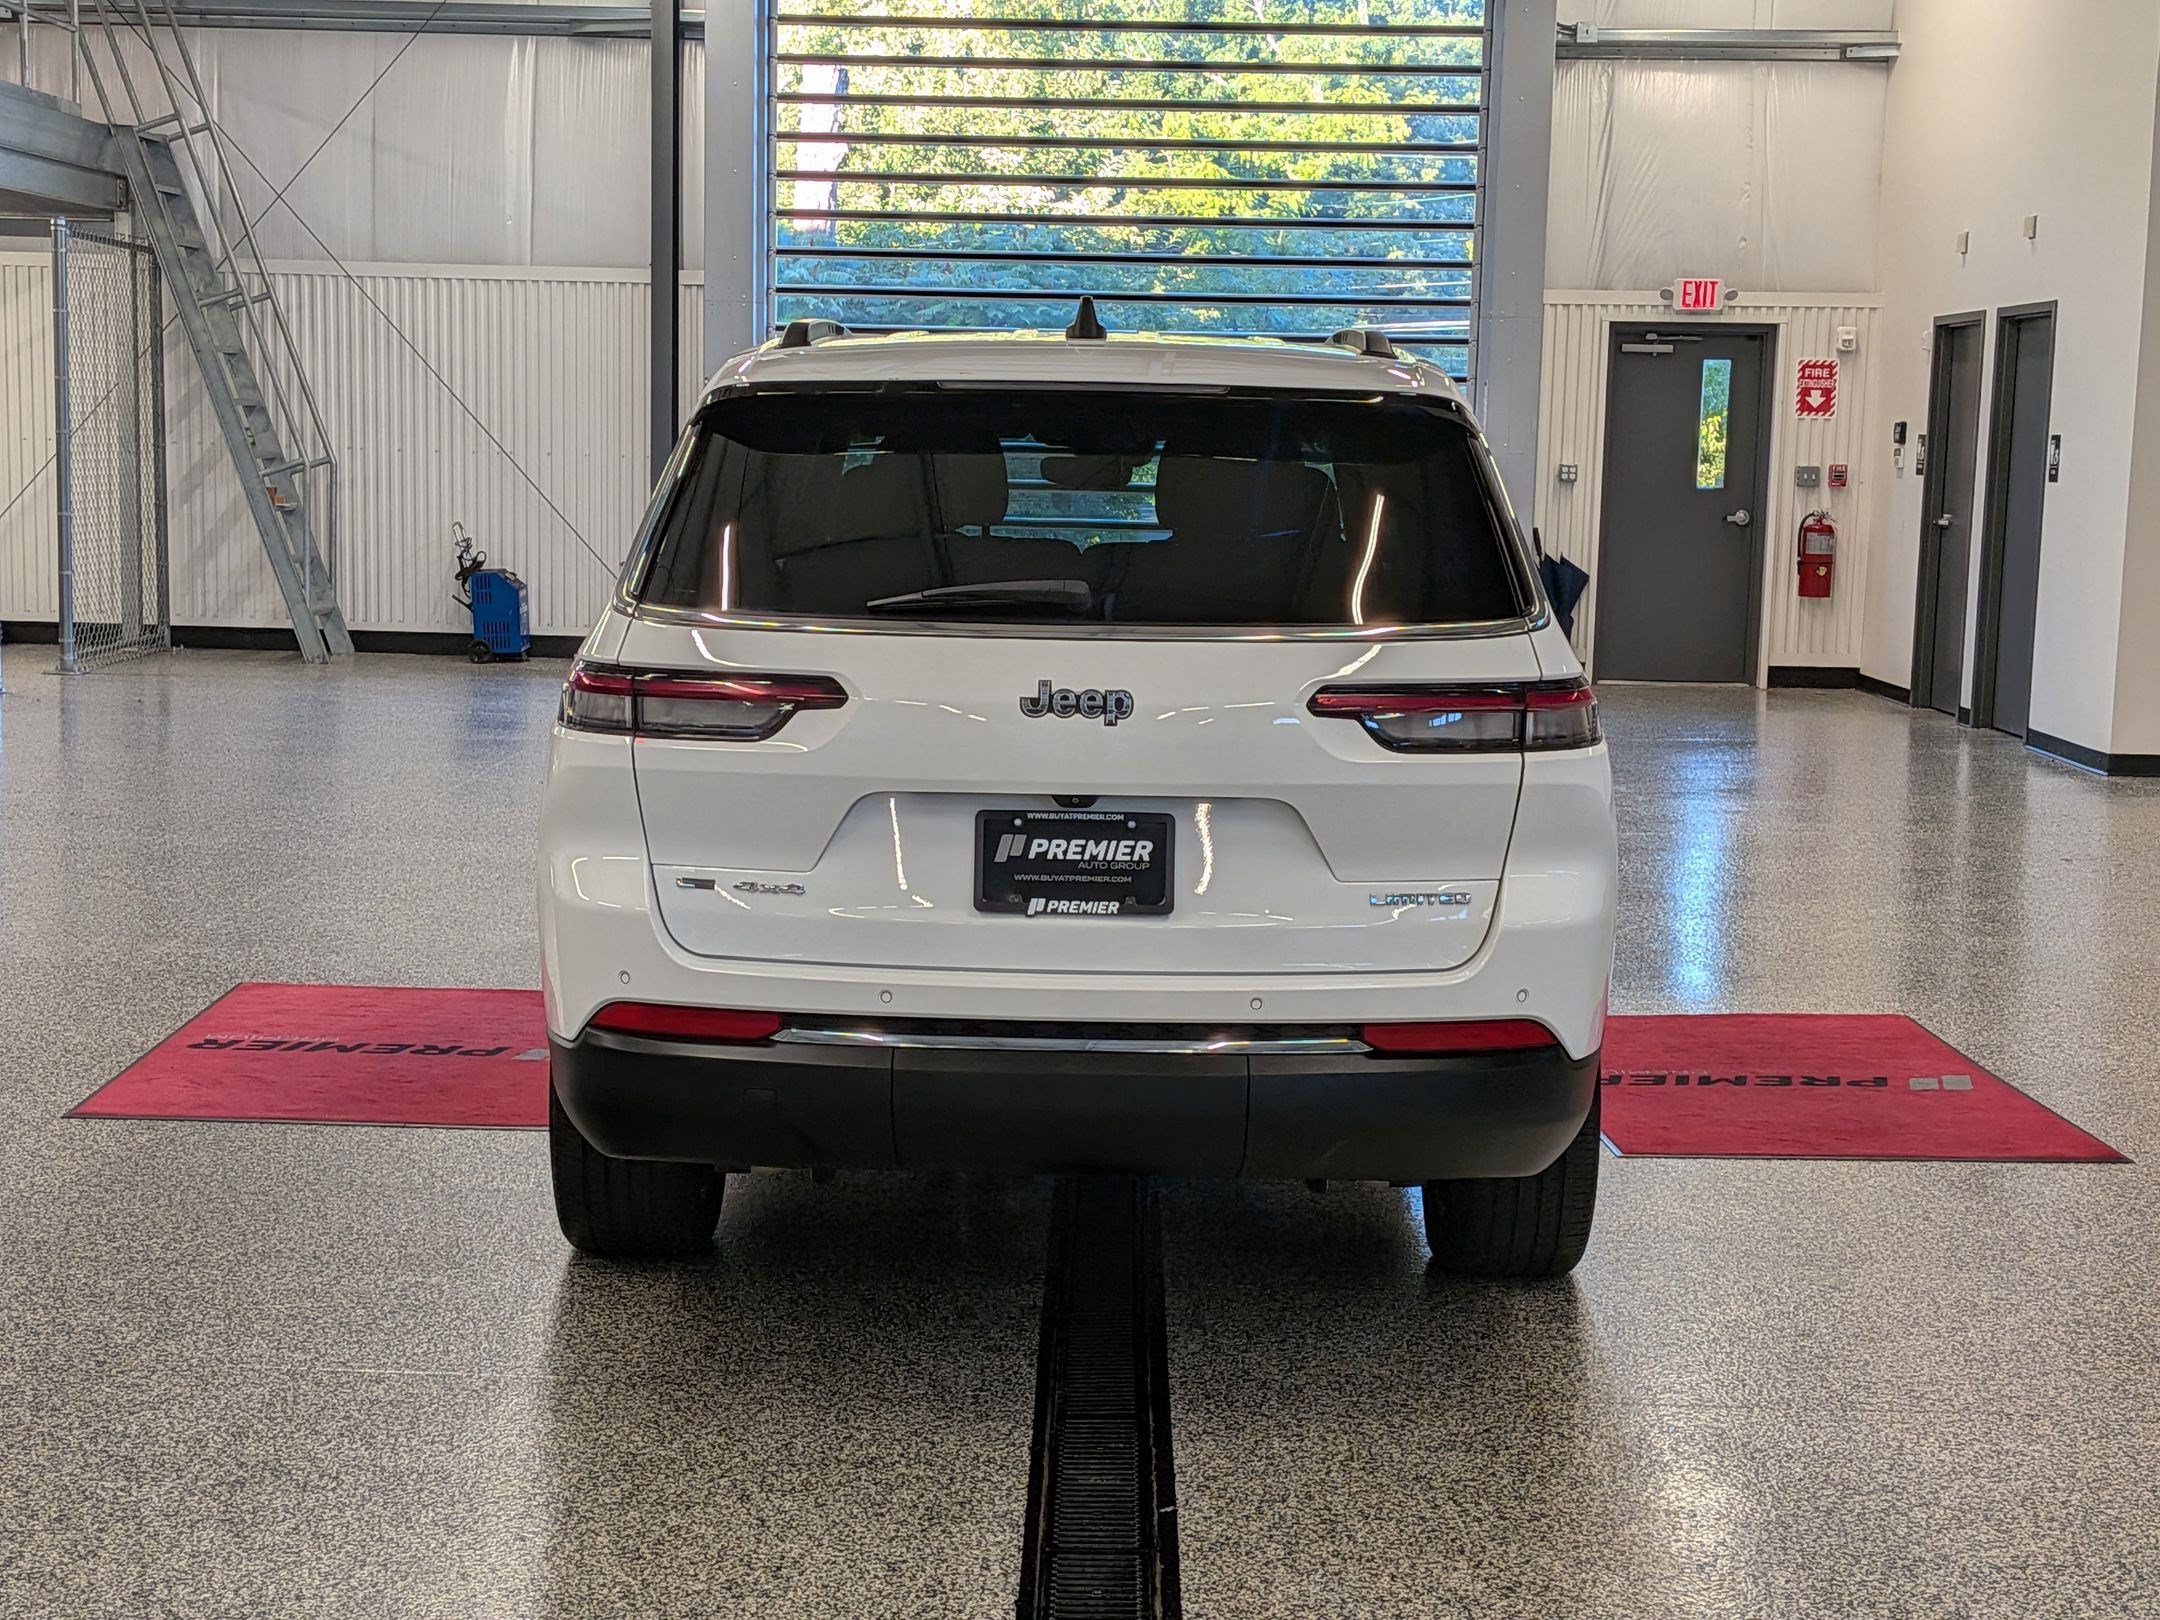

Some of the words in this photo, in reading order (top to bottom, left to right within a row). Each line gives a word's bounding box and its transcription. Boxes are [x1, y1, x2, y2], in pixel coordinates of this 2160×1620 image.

[1681, 280, 1719, 308] EXIT
[1804, 367, 1831, 379] FIRE
[1020, 679, 1134, 727] Jeep
[1026, 812, 1124, 821] WWW.BUYATPREMIER.COM
[1028, 838, 1154, 862] PREMIER
[1077, 861, 1108, 870] AUTO
[1110, 862, 1150, 870] GROUP
[1013, 873, 1132, 883] WWW.BUYATPREMIER.COM
[1369, 892, 1472, 906] LIMITED
[1047, 900, 1120, 915] PREMIER
[187, 1038, 511, 1057] PREMIER
